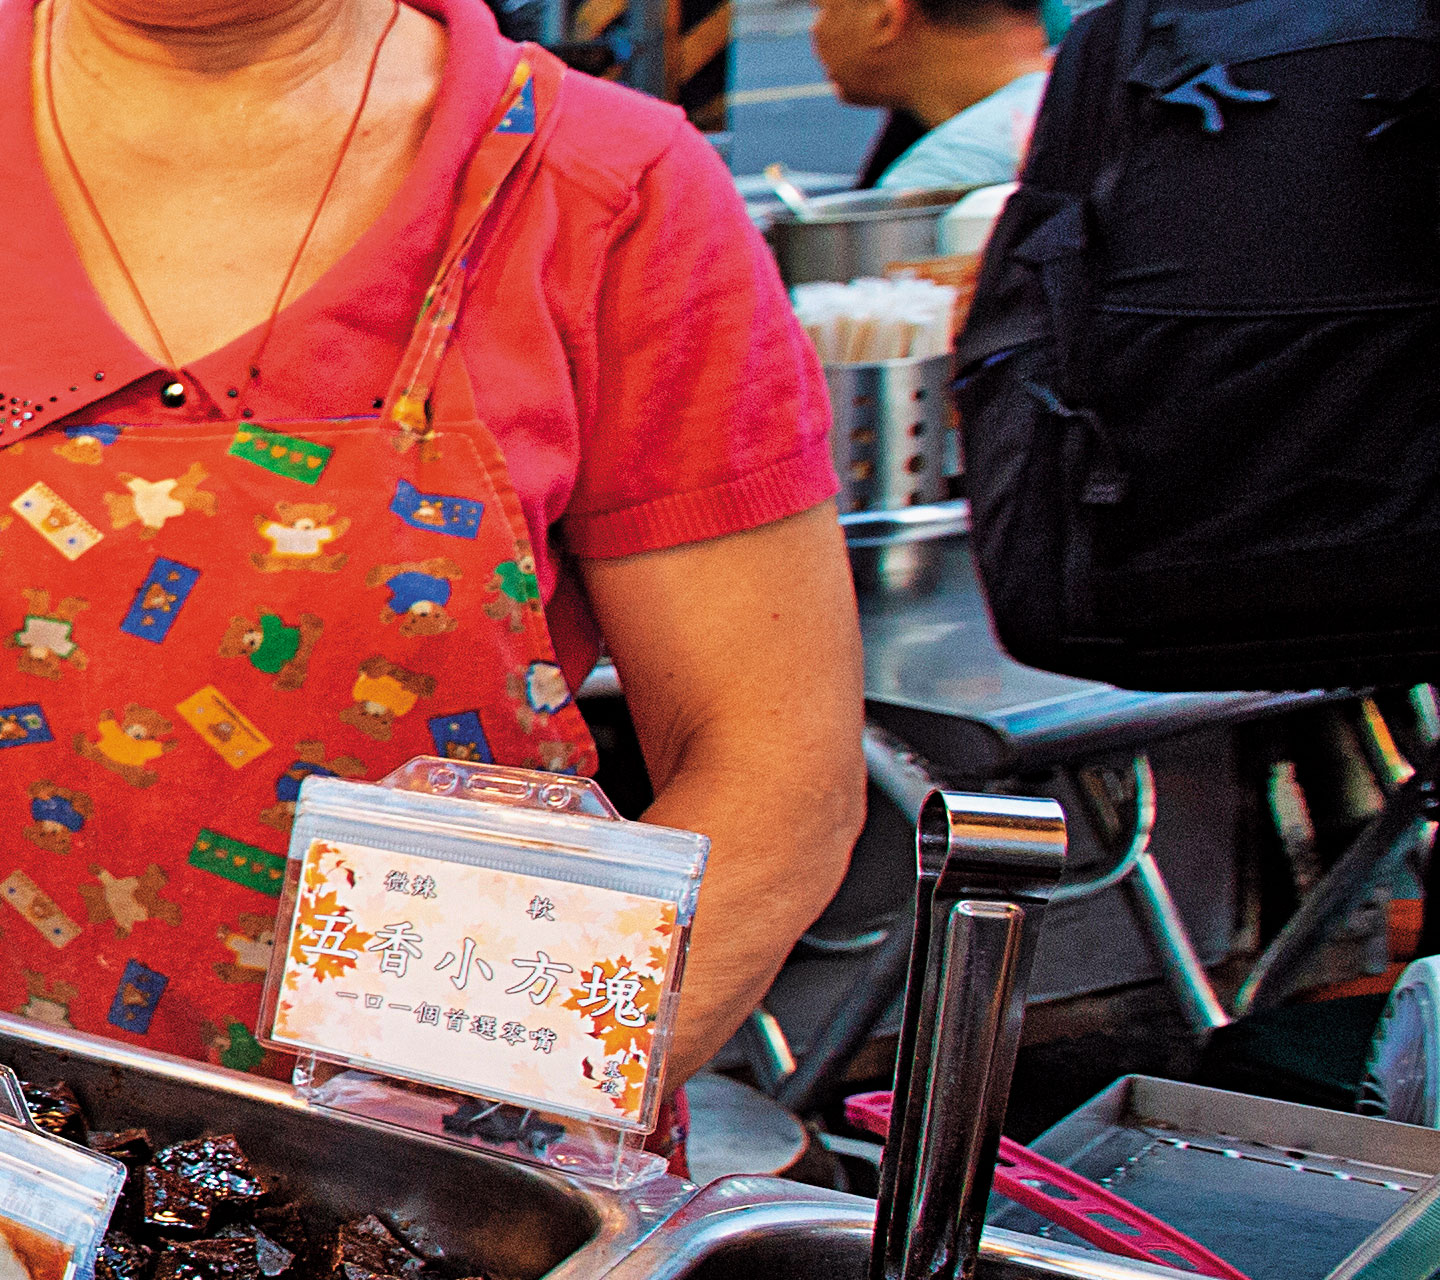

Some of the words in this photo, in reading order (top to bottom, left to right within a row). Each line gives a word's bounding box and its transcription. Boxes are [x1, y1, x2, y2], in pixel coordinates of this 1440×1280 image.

[384, 869, 438, 899] 微辣
[527, 895, 556, 922] 軟
[300, 913, 647, 1029] 五香小方塊
[336, 989, 558, 1055] 一口一個首選零嘴
